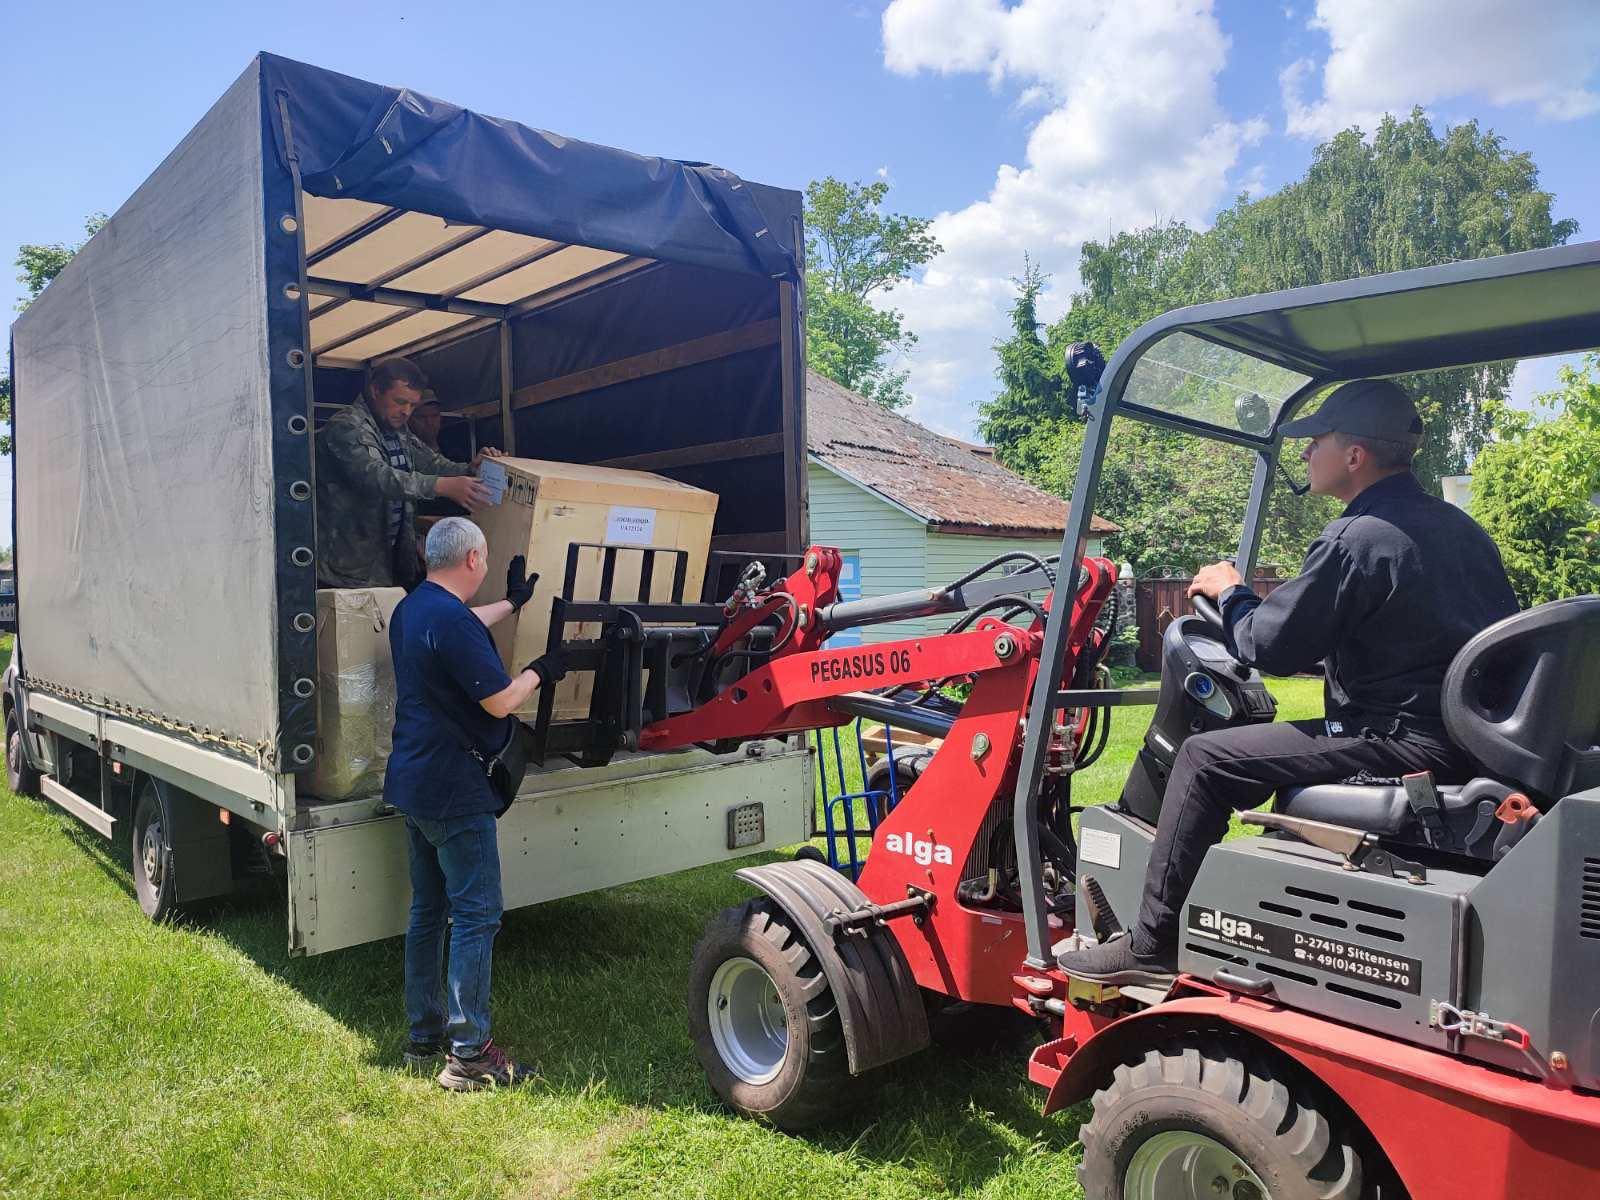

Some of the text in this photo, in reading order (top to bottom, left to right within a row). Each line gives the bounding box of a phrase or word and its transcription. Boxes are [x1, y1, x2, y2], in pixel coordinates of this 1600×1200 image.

[811, 649, 911, 683] PEGASUS 06
[886, 831, 953, 866] alga
[1294, 933, 1409, 971] D-27419 Sittensen
